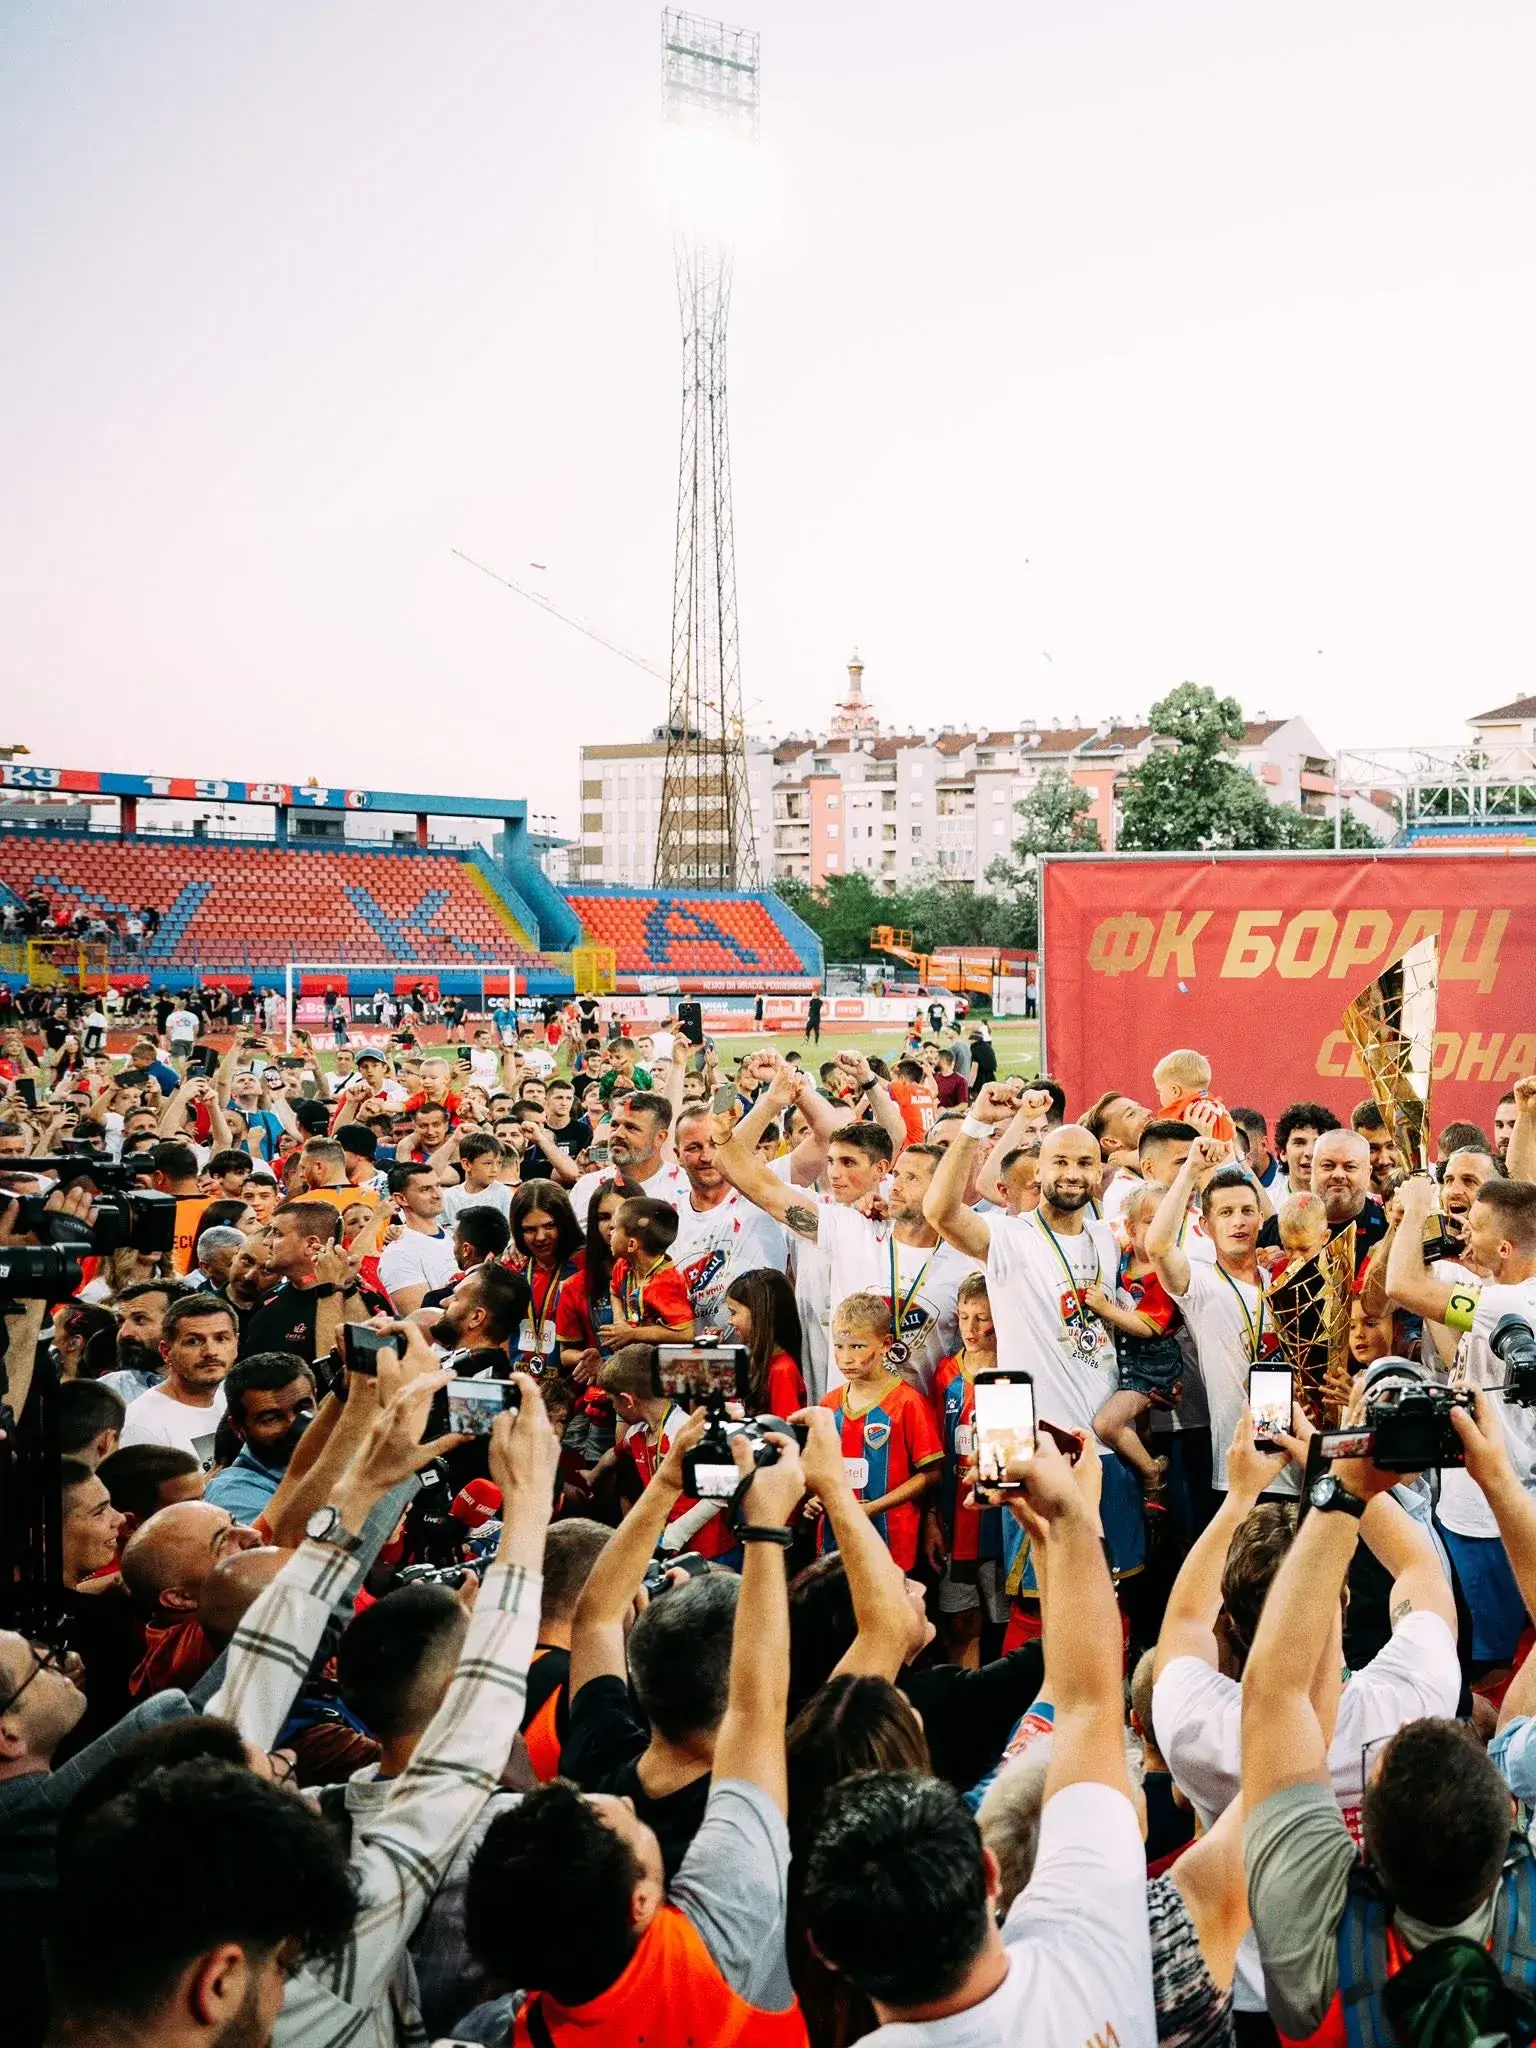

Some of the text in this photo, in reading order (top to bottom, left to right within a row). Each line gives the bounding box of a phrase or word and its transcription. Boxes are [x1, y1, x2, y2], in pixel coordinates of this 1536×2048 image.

[1087, 909, 1214, 979] ФК
[1315, 1029, 1536, 1082] СОНА
[920, 1107, 934, 1131] 18
